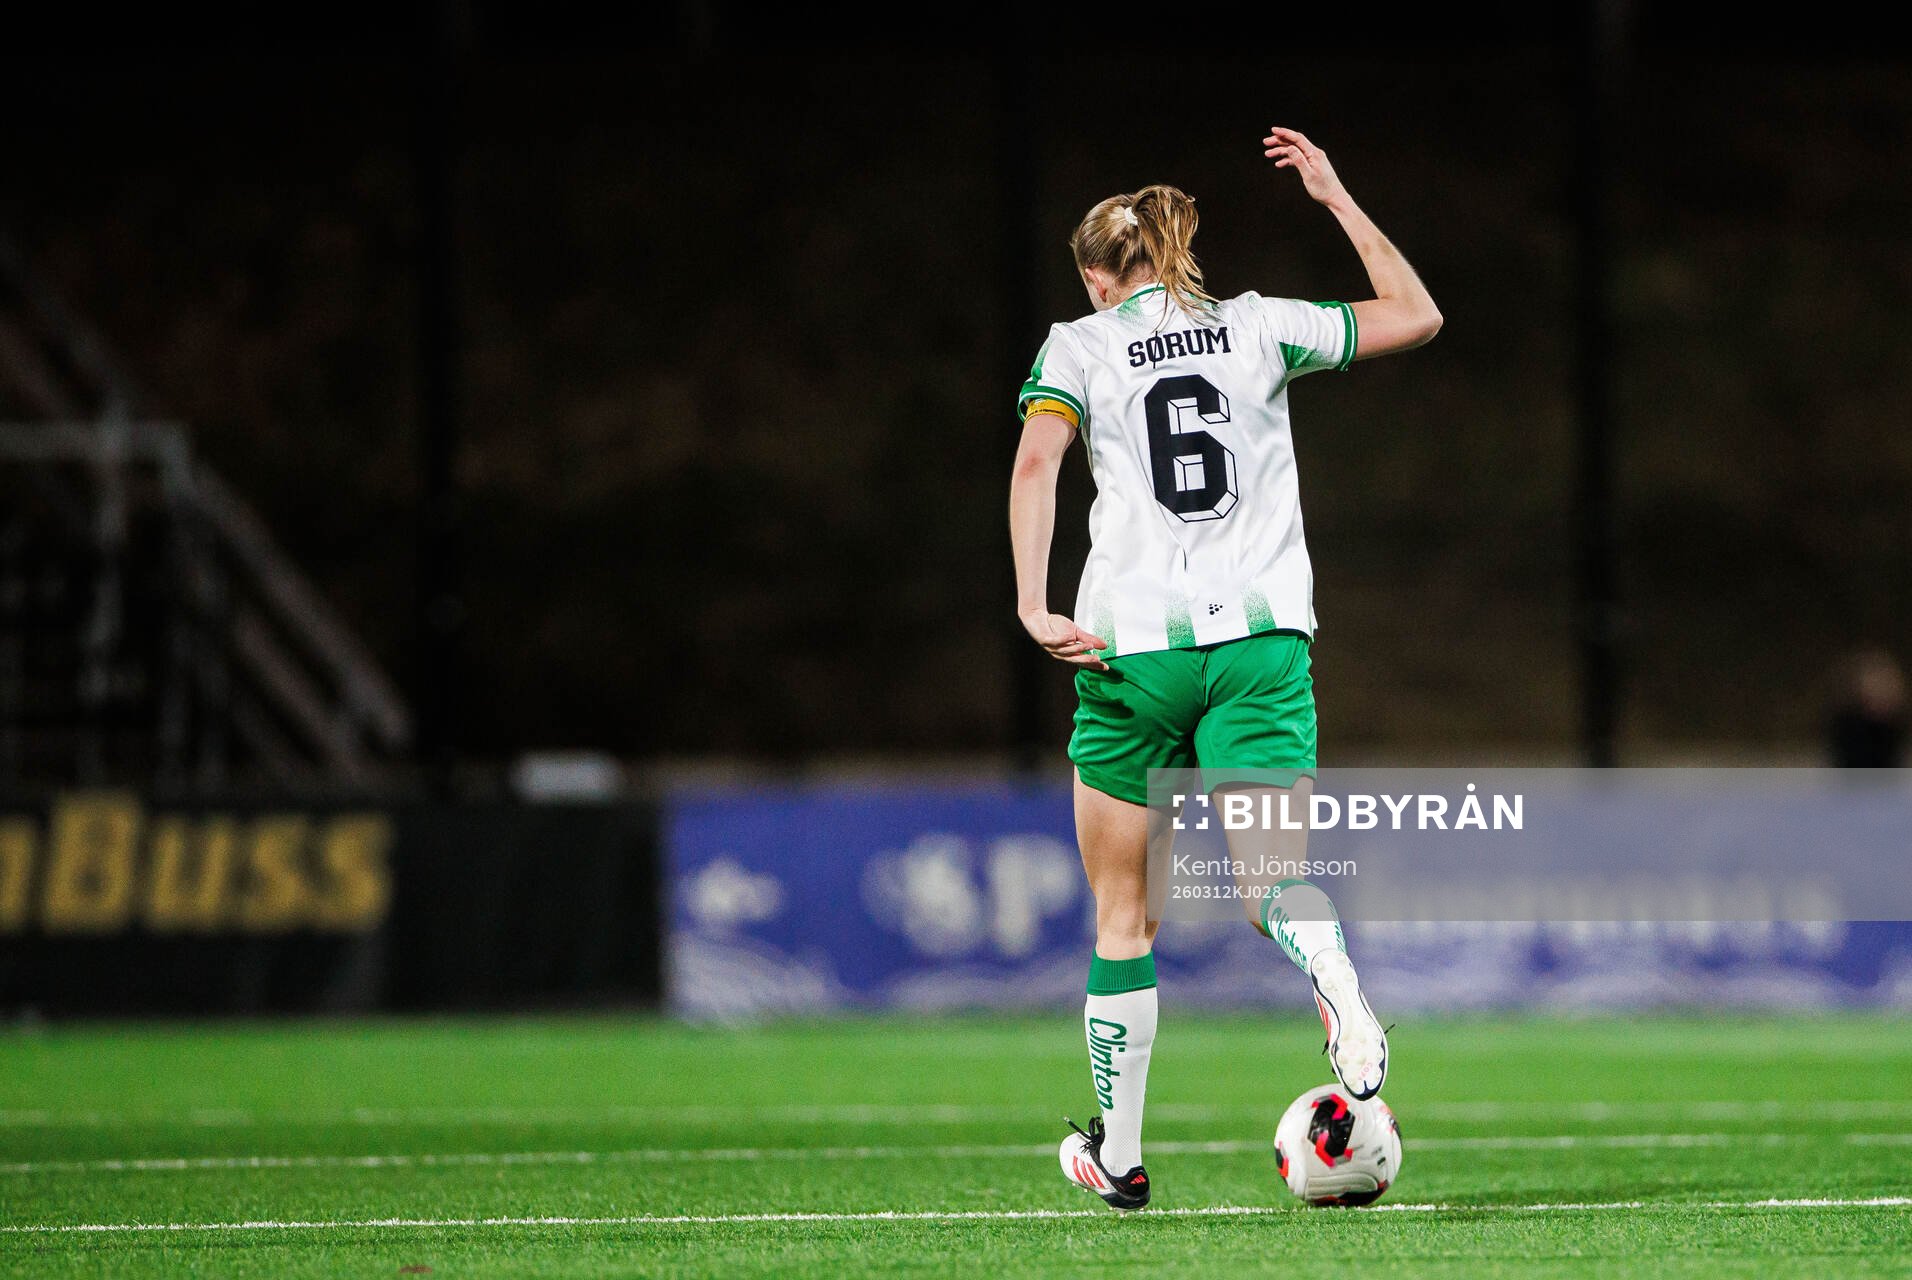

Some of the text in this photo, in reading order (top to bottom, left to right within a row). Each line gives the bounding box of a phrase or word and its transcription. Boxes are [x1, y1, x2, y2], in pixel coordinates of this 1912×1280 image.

[1128, 327, 1231, 369] SØRUM
[1145, 374, 1239, 522] 6
[1089, 1017, 1127, 1111] Clinton
